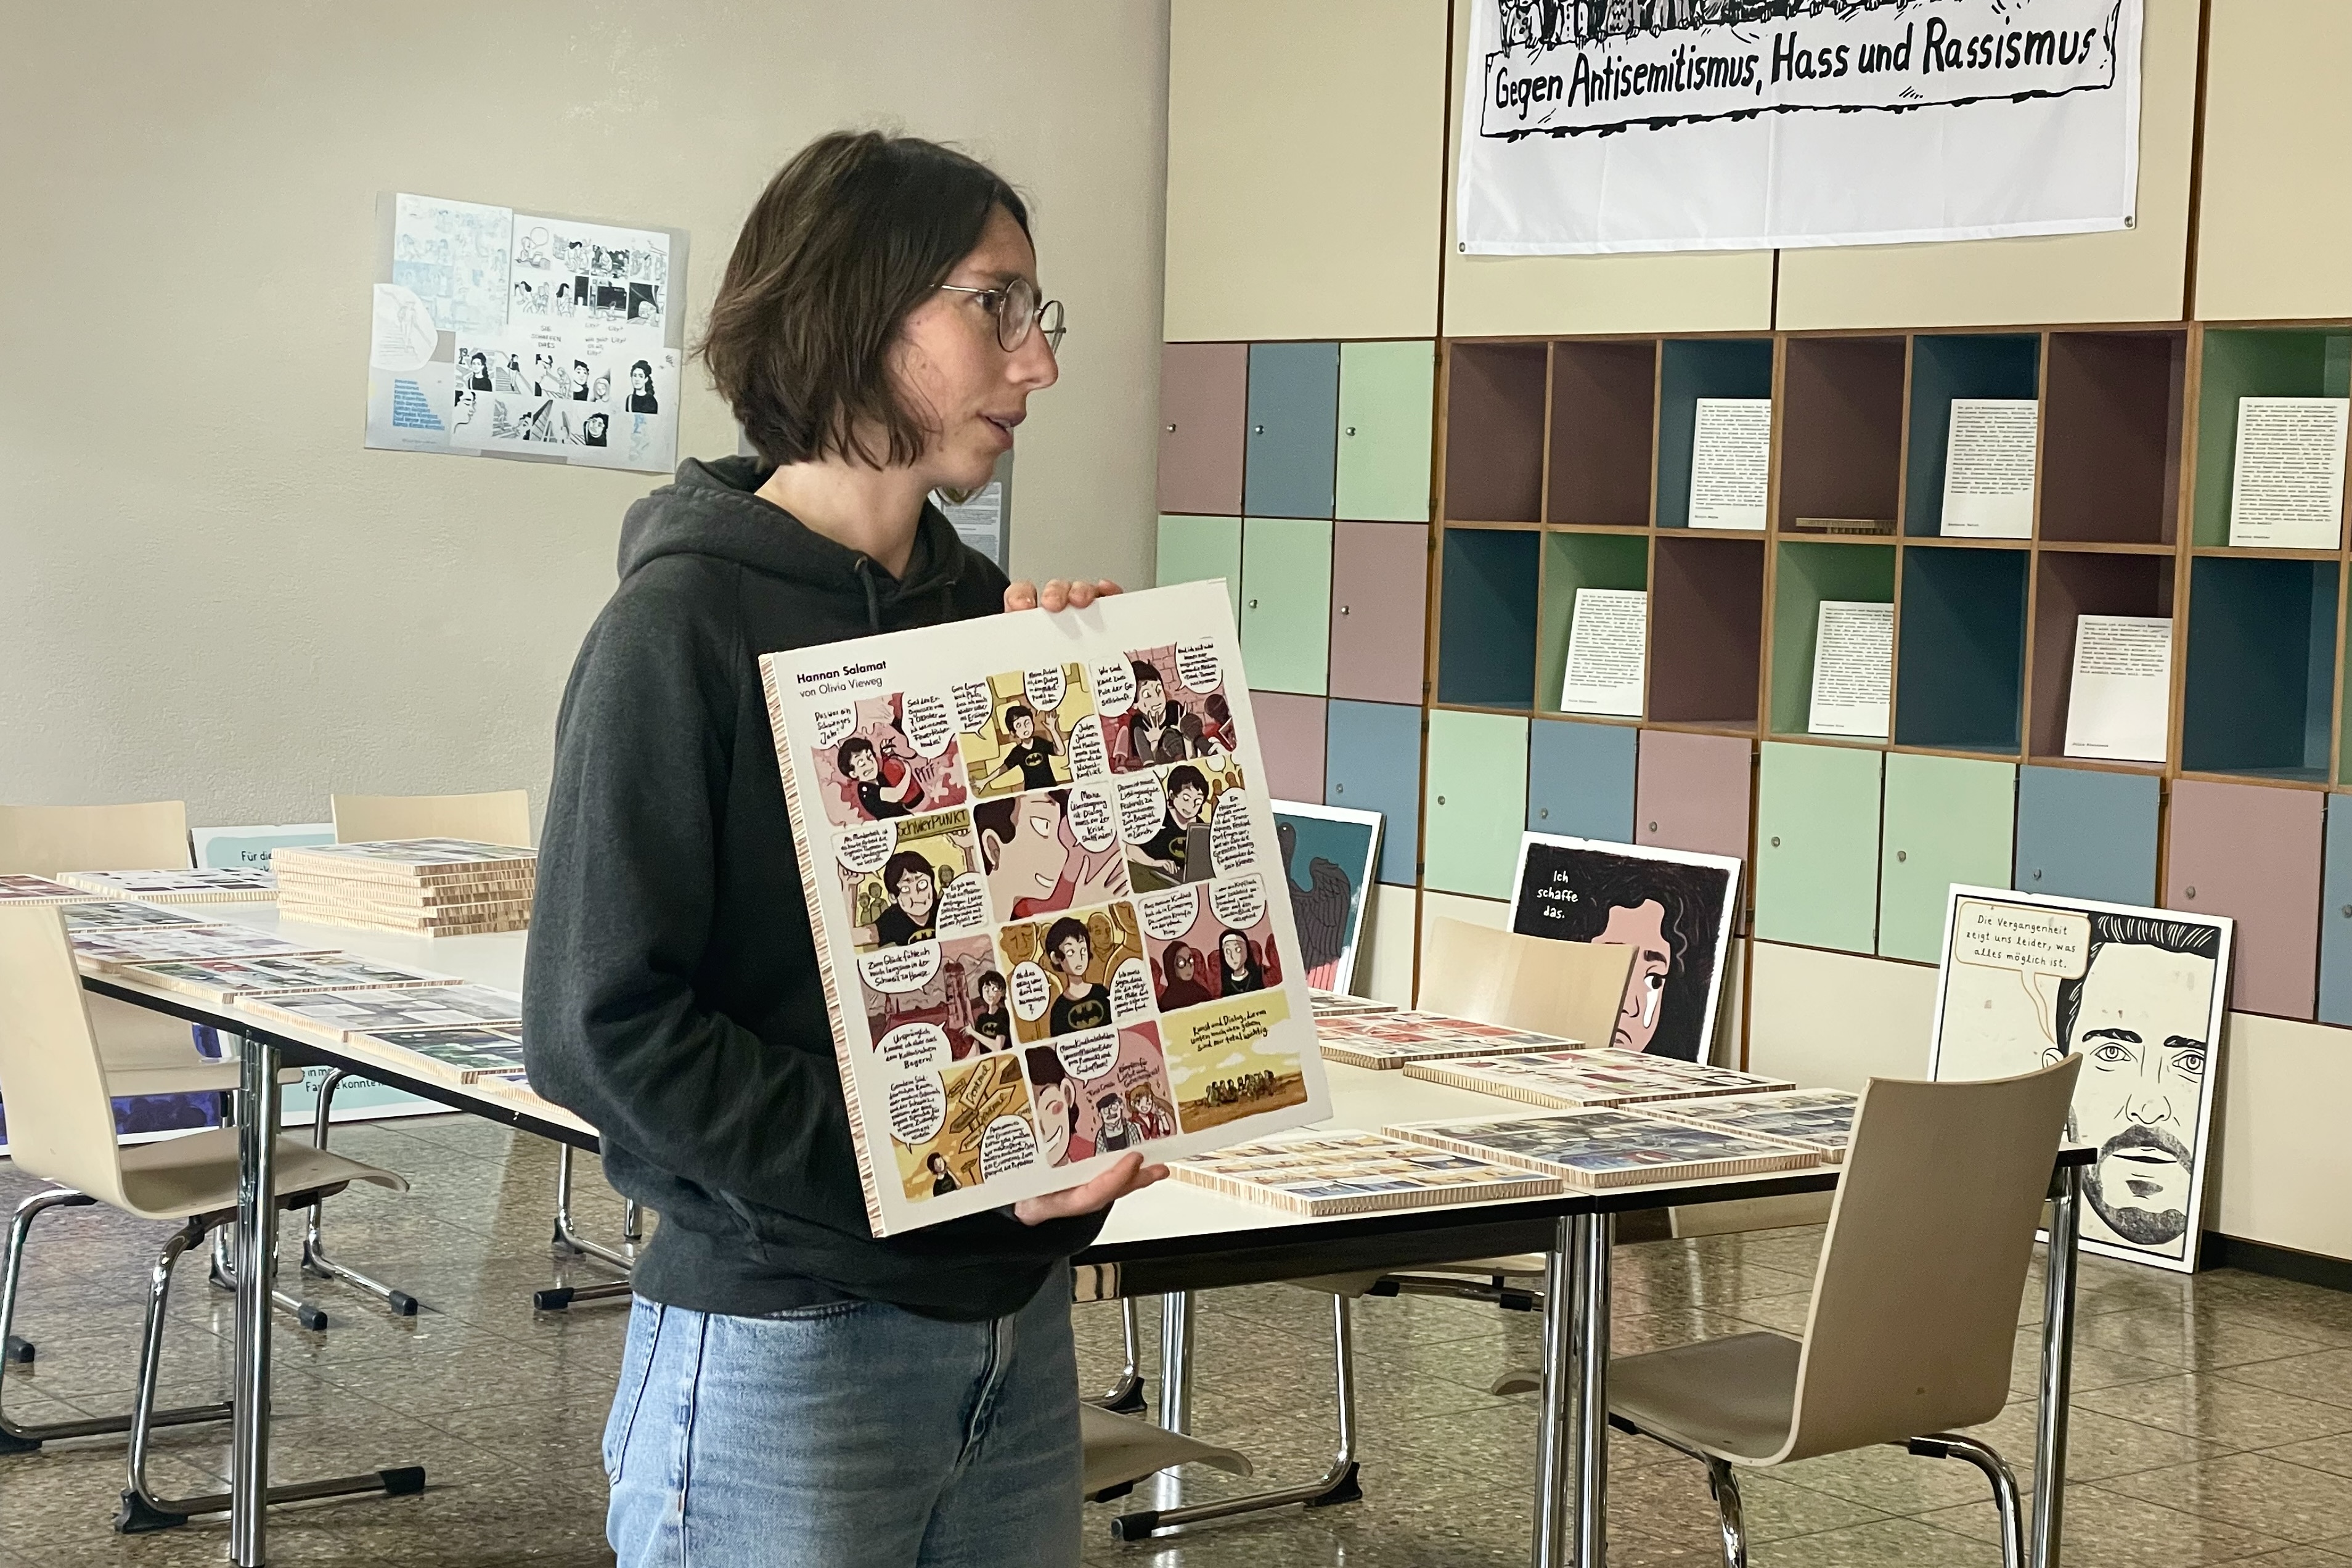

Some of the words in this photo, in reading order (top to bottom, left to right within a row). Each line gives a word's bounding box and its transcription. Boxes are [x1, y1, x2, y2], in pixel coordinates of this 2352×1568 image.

[1495, 67, 1563, 120] Gegen
[1567, 44, 1762, 107] Antisemitismus,
[1771, 31, 1850, 84] Hass
[1858, 22, 1913, 73] und
[1923, 17, 2097, 75] Rassismus
[797, 671, 839, 683] Hannan
[843, 661, 886, 675] Salamat
[799, 689, 815, 697] von
[819, 683, 846, 693] Olivia
[848, 677, 882, 688] Vieweg
[241, 851, 257, 861] Für
[1553, 870, 1568, 883] Ich
[1537, 887, 1578, 902] schaffe
[1543, 905, 1565, 919] das.
[1977, 915, 1992, 925] Die
[1998, 918, 2067, 936] Vergangenheit
[1966, 931, 1990, 943] zeigt
[1995, 935, 2011, 944] uns
[2016, 936, 2051, 951] leider,
[2056, 944, 2076, 952] was
[1974, 948, 2001, 959] alles
[2006, 952, 2046, 965] möglich
[2050, 957, 2067, 968] ist.
